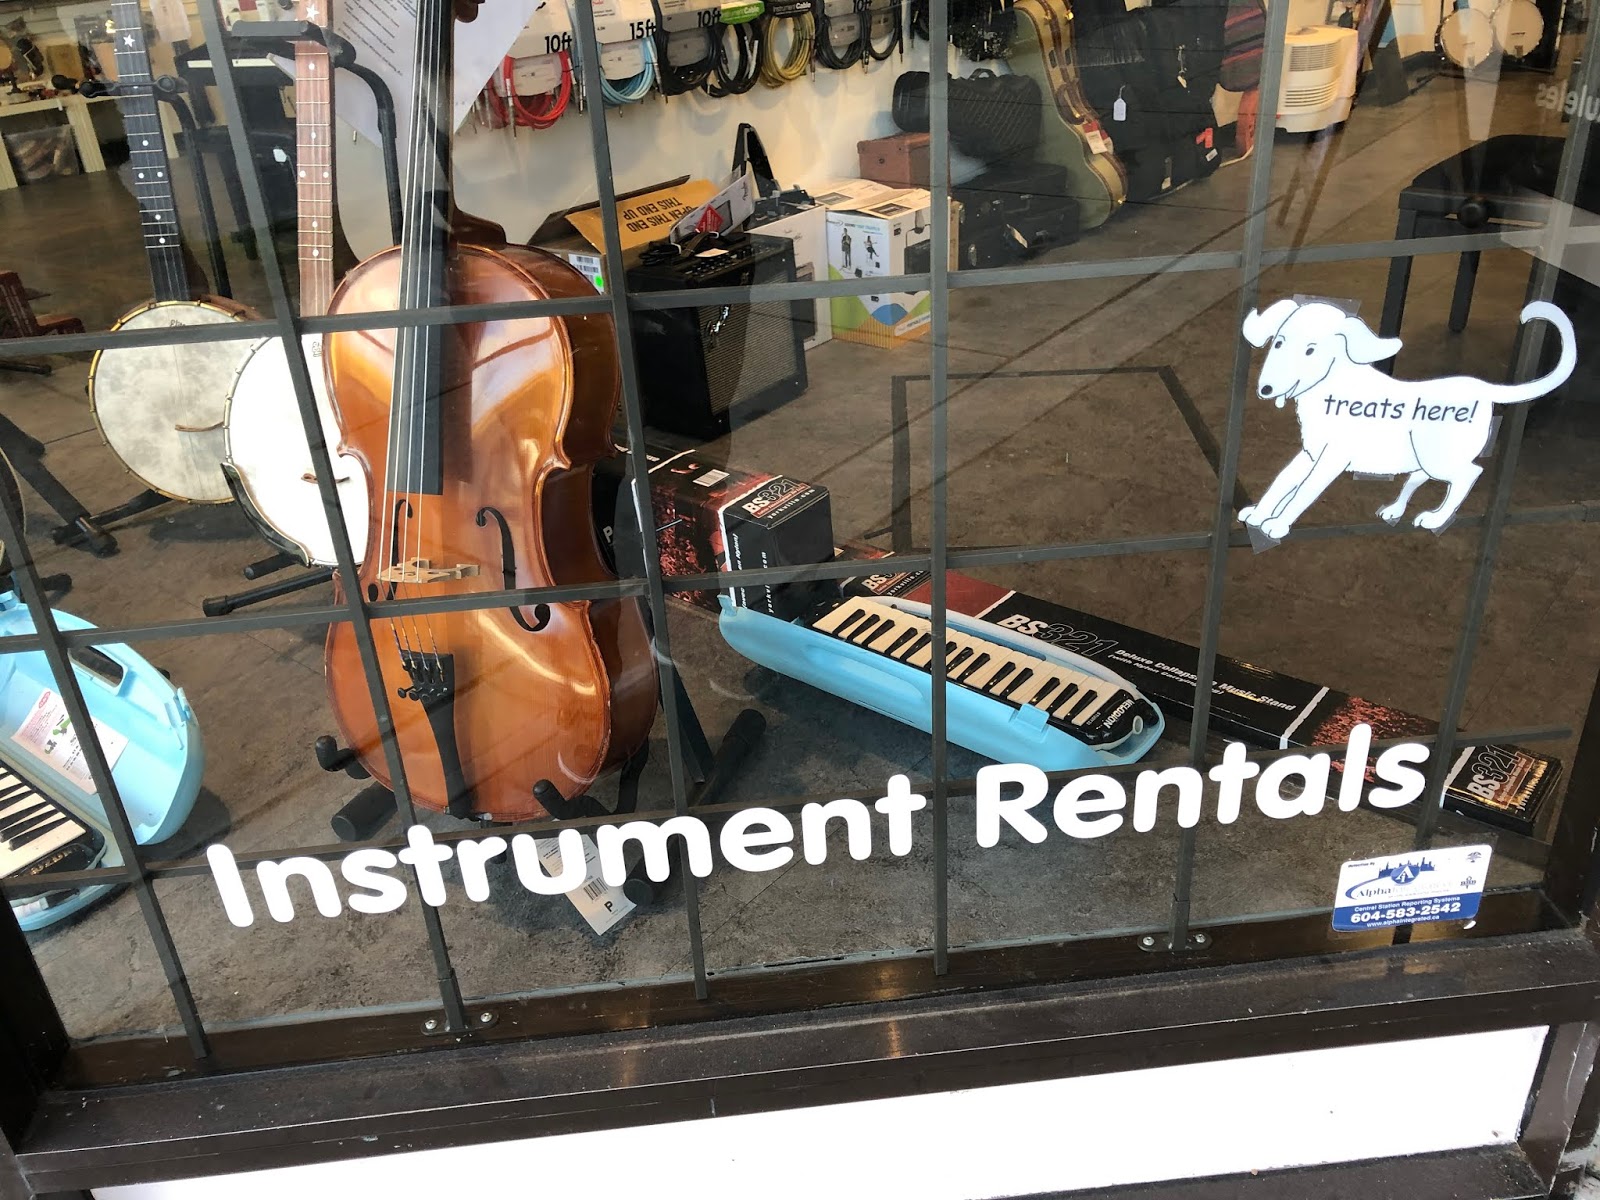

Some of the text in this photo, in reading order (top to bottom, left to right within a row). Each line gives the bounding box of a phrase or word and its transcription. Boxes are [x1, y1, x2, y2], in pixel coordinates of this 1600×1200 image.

[743, 6, 760, 14] Cable
[795, 2, 812, 10] Cable
[697, 8, 722, 27] 10ft
[629, 19, 657, 40] 15ft
[544, 31, 573, 54] 10ft
[622, 196, 683, 221] THIS END UP
[626, 221, 648, 233] END
[650, 213, 672, 227] THIS
[1324, 394, 1479, 423] treats here!
[742, 478, 800, 514] BS321
[996, 614, 1119, 657] BS321
[1114, 649, 1154, 665] Deluxe
[1254, 694, 1297, 712] Stand
[1466, 744, 1521, 801] BS321
[206, 723, 1430, 927] Instrument Rentals
[604, 901, 613, 913] P
[1350, 902, 1461, 923] 604-583-2542
[1354, 895, 1461, 912] Central Station Reporting Systems
[1366, 914, 1440, 928] www.alphaintegrated.ca
